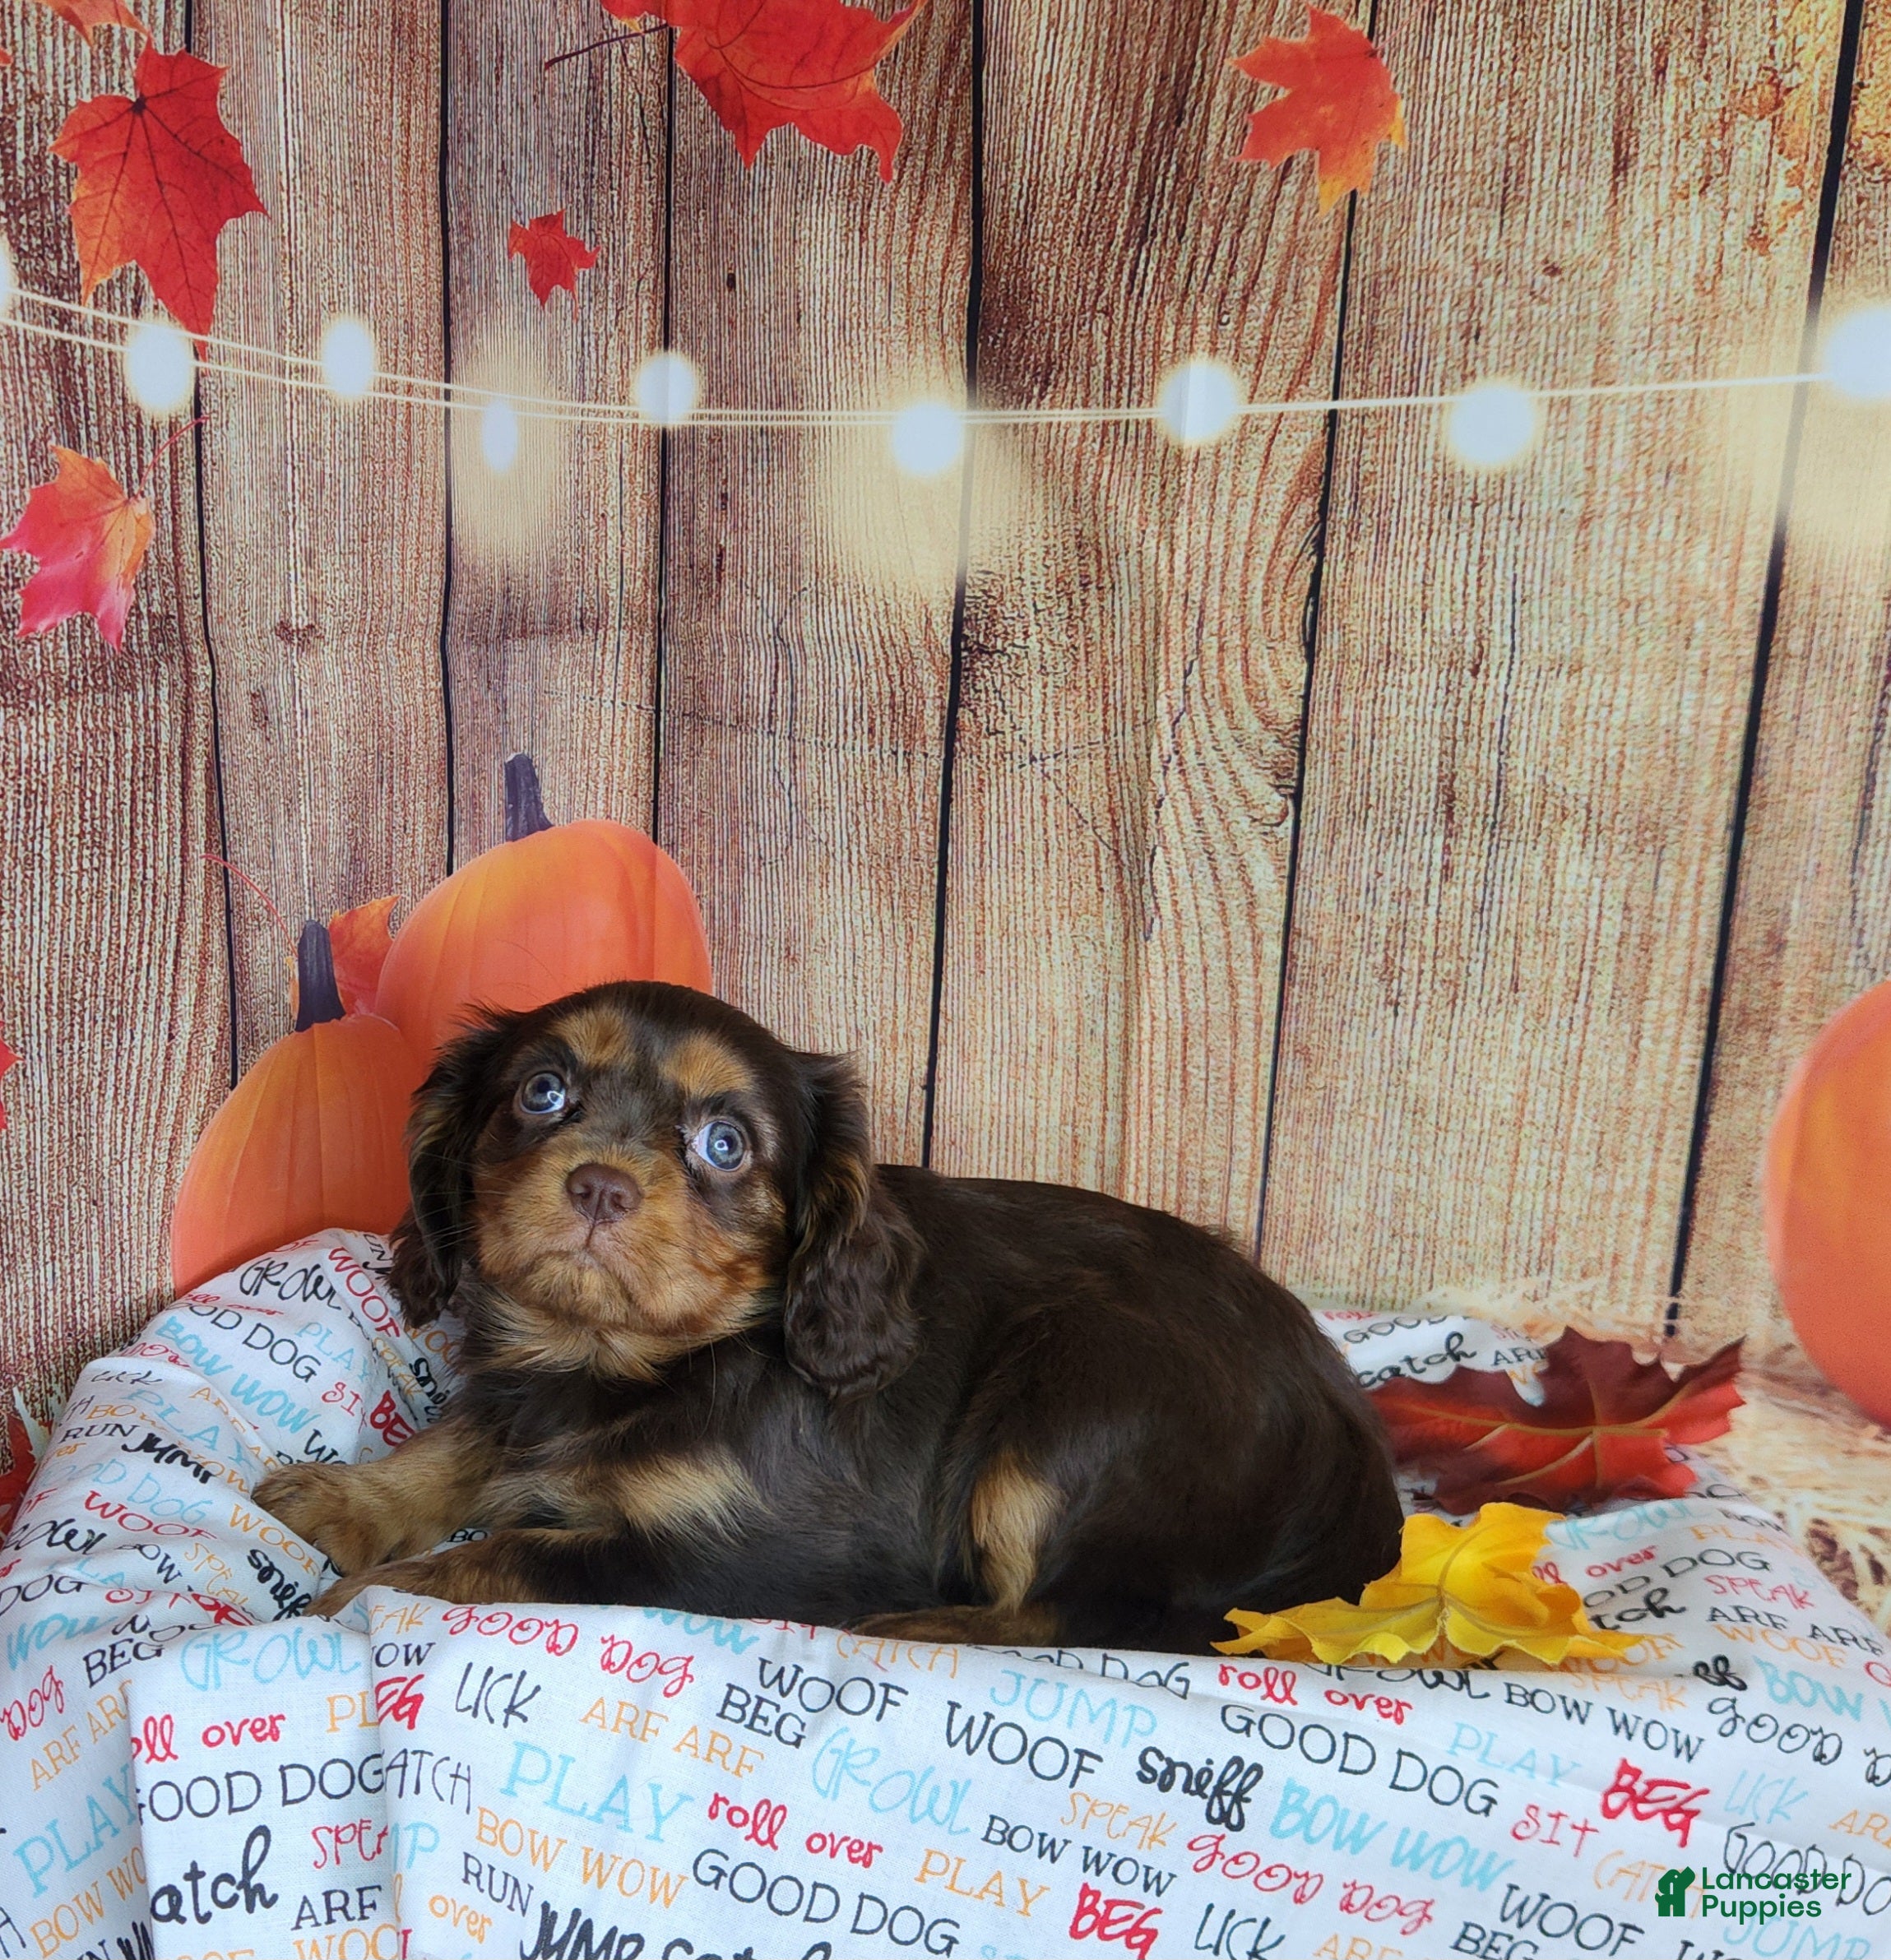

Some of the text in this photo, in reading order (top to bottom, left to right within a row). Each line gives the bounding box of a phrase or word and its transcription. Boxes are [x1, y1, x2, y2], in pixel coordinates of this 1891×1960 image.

[327, 1246, 401, 1338] WOOF
[155, 1315, 233, 1377] BOW
[230, 1374, 322, 1434] WOW
[242, 1323, 322, 1383] DOG
[295, 1321, 368, 1382] PLAY
[58, 1423, 141, 1444] RUN
[85, 1490, 217, 1539] WOOF
[127, 1472, 213, 1523] DOG
[228, 1504, 316, 1576] WOOF
[1660, 1548, 1771, 1578] DOG
[1704, 1573, 1816, 1610] SPEAK
[7, 1612, 118, 1670] WOW
[82, 1638, 165, 1688] BEG
[180, 1626, 362, 1692] GROWL
[1706, 1605, 1884, 1657] ARF ARF
[1713, 1624, 1849, 1669] WOOF
[454, 1661, 542, 1729] LICK
[716, 1682, 807, 1749] BEG
[758, 1657, 909, 1722] WOOF
[990, 1668, 1159, 1749] JUMP
[1217, 1663, 1299, 1707] roll
[1324, 1689, 1414, 1726] over
[1569, 1672, 1689, 1712] SPEAK
[1752, 1654, 1865, 1721] BOW
[202, 1713, 286, 1748] over
[580, 1695, 766, 1780] ARF ARF
[946, 1700, 1104, 1789] WOOF
[1446, 1721, 1582, 1787] PLAY
[1504, 1681, 1594, 1726] BOW
[1606, 1706, 1706, 1764] WOW
[29, 1725, 81, 1791] ARF
[136, 1752, 386, 1825] OOD DOG
[812, 1727, 972, 1837] GROWL
[1221, 1703, 1499, 1818] GOOD DOG
[499, 1740, 694, 1844] PLAY
[1060, 1791, 1179, 1851] SPEAK
[1601, 1757, 1710, 1849] BEG
[1723, 1769, 1809, 1823] LICK
[475, 1805, 568, 1874] BOW
[581, 1846, 689, 1909] WOW
[708, 1792, 883, 1869] roll over
[981, 1814, 1179, 1897] BOW WOW
[1269, 1777, 1518, 1893] BOW WOW
[290, 1884, 383, 1932] ARF
[461, 1851, 534, 1917] RUN
[693, 1848, 961, 1958] GOOD DOG
[914, 1848, 1050, 1917] PLAY
[29, 1880, 104, 1958] BOW
[429, 1894, 493, 1944] over
[1068, 1882, 1163, 1960] BEG
[1193, 1902, 1286, 1960] LICK
[1499, 1883, 1645, 1957] WOOF
